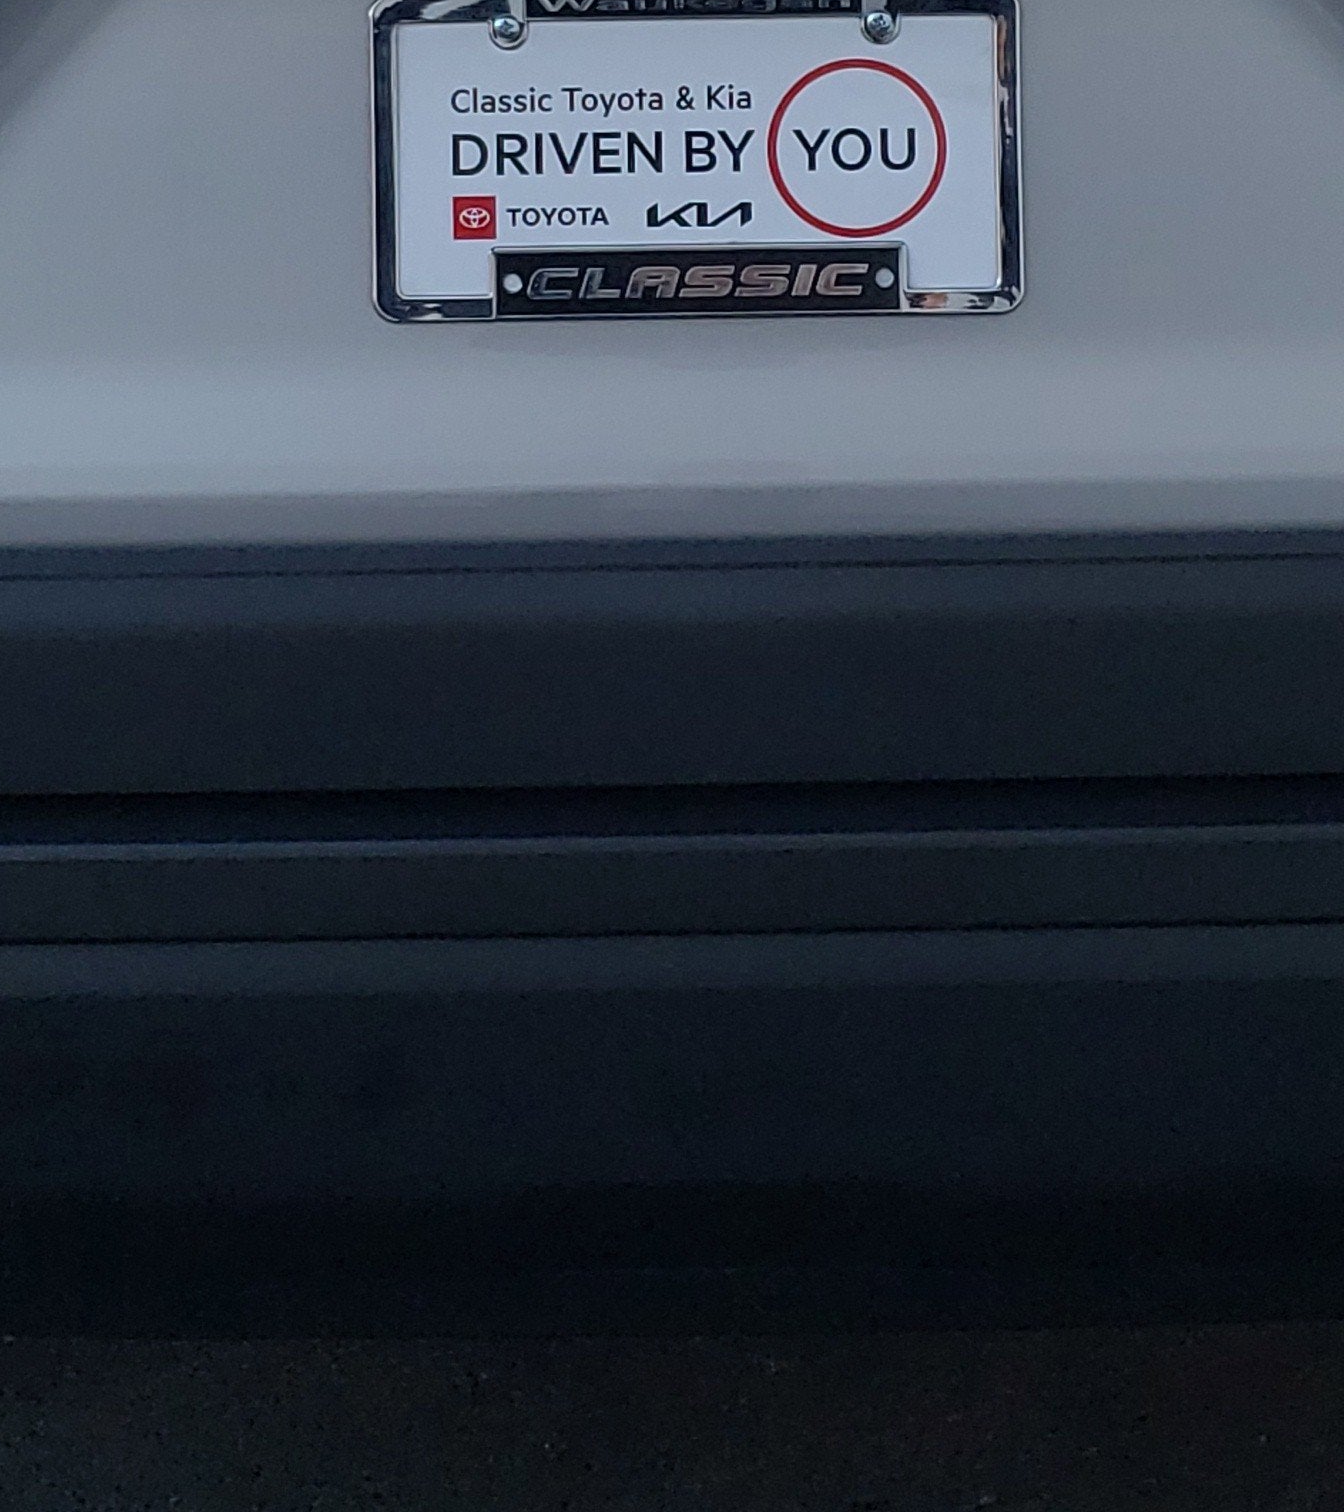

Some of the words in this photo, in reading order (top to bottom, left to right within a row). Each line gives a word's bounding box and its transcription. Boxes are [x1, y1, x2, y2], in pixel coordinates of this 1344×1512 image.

[450, 88, 553, 114] Classic
[561, 87, 664, 117] Toyota
[676, 86, 696, 110] &
[707, 85, 753, 110] Kia
[452, 130, 664, 177] DRIVEN
[685, 129, 755, 174] BY
[792, 126, 918, 172] YOU
[506, 206, 610, 228] TOYOTA
[527, 263, 870, 299] CLASSIC
